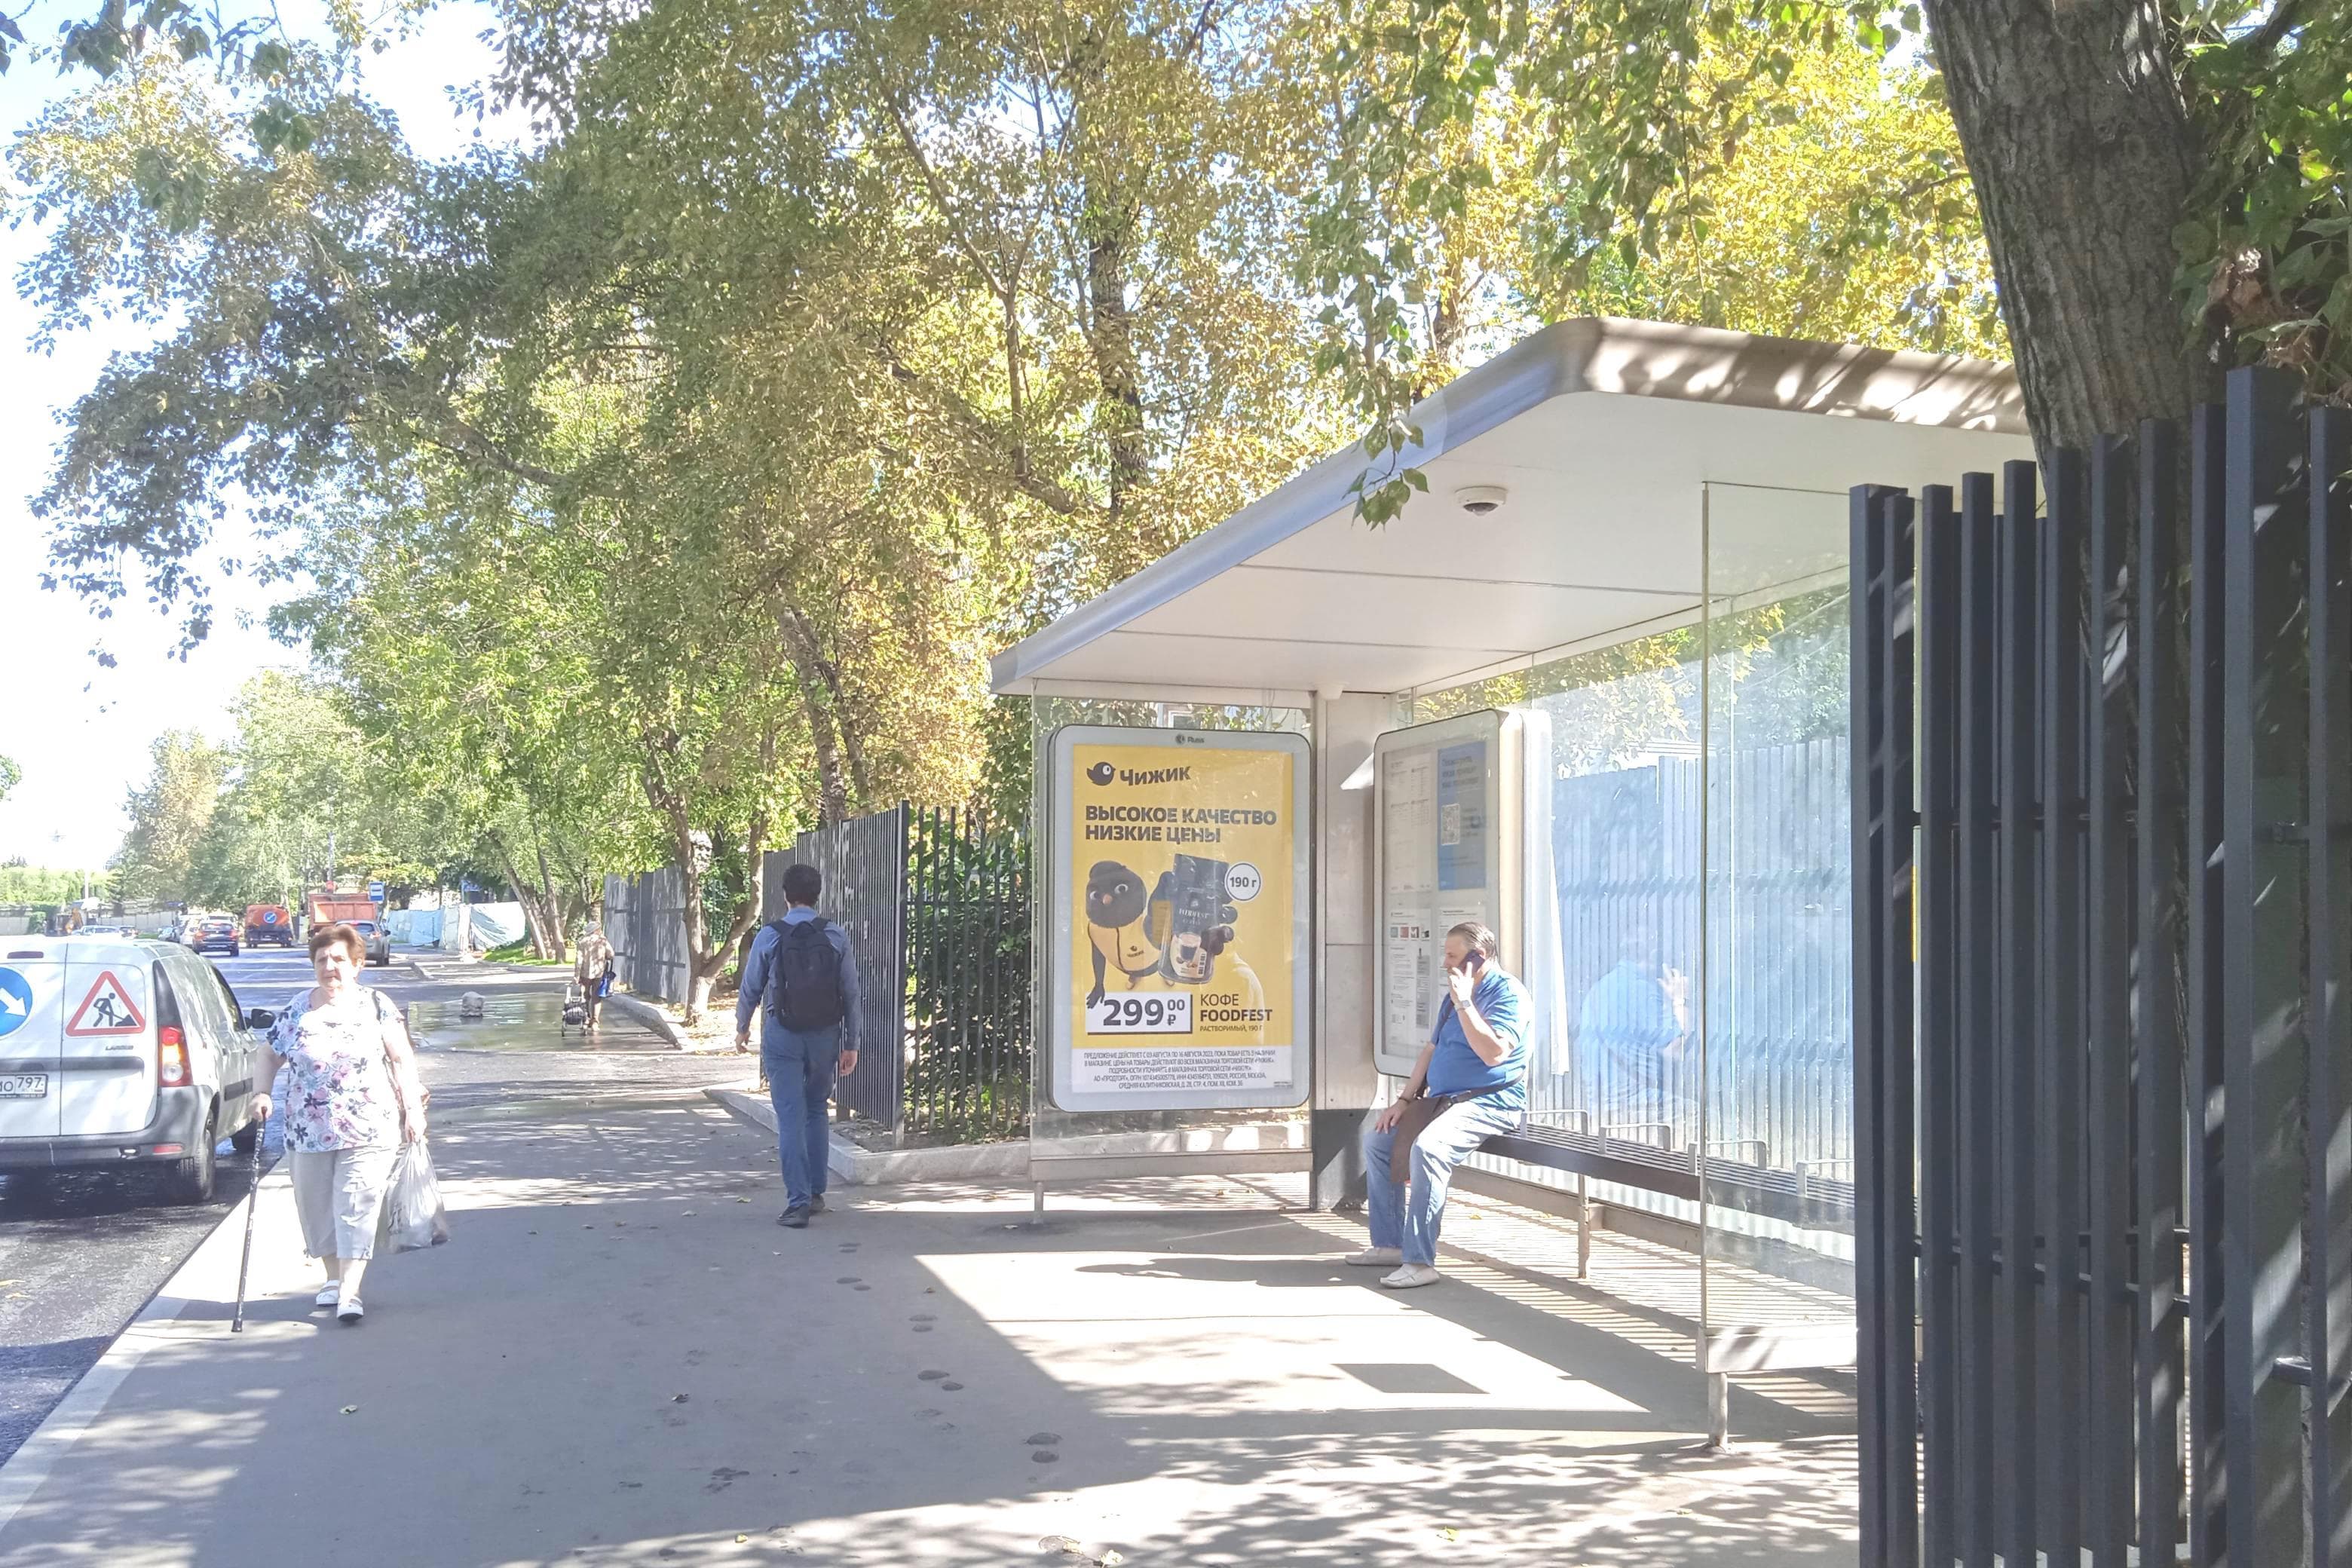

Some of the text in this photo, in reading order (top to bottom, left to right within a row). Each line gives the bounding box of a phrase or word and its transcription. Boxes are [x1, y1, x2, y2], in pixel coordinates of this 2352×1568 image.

[1086, 806, 1277, 825] ВЫСОКОЕ КАЧЕСТВО
[1086, 825, 1220, 844] НИЗКИЕ ЦЕНЫ
[1230, 877, 1249, 887] 190
[1200, 994, 1239, 1006] КОФЕ
[1103, 999, 1185, 1026] 299 00
[1200, 1009, 1272, 1021] FOODFEST
[1200, 1024, 1248, 1032] РАСТВОРИМЫЙ,
[17, 1076, 43, 1089] 797
